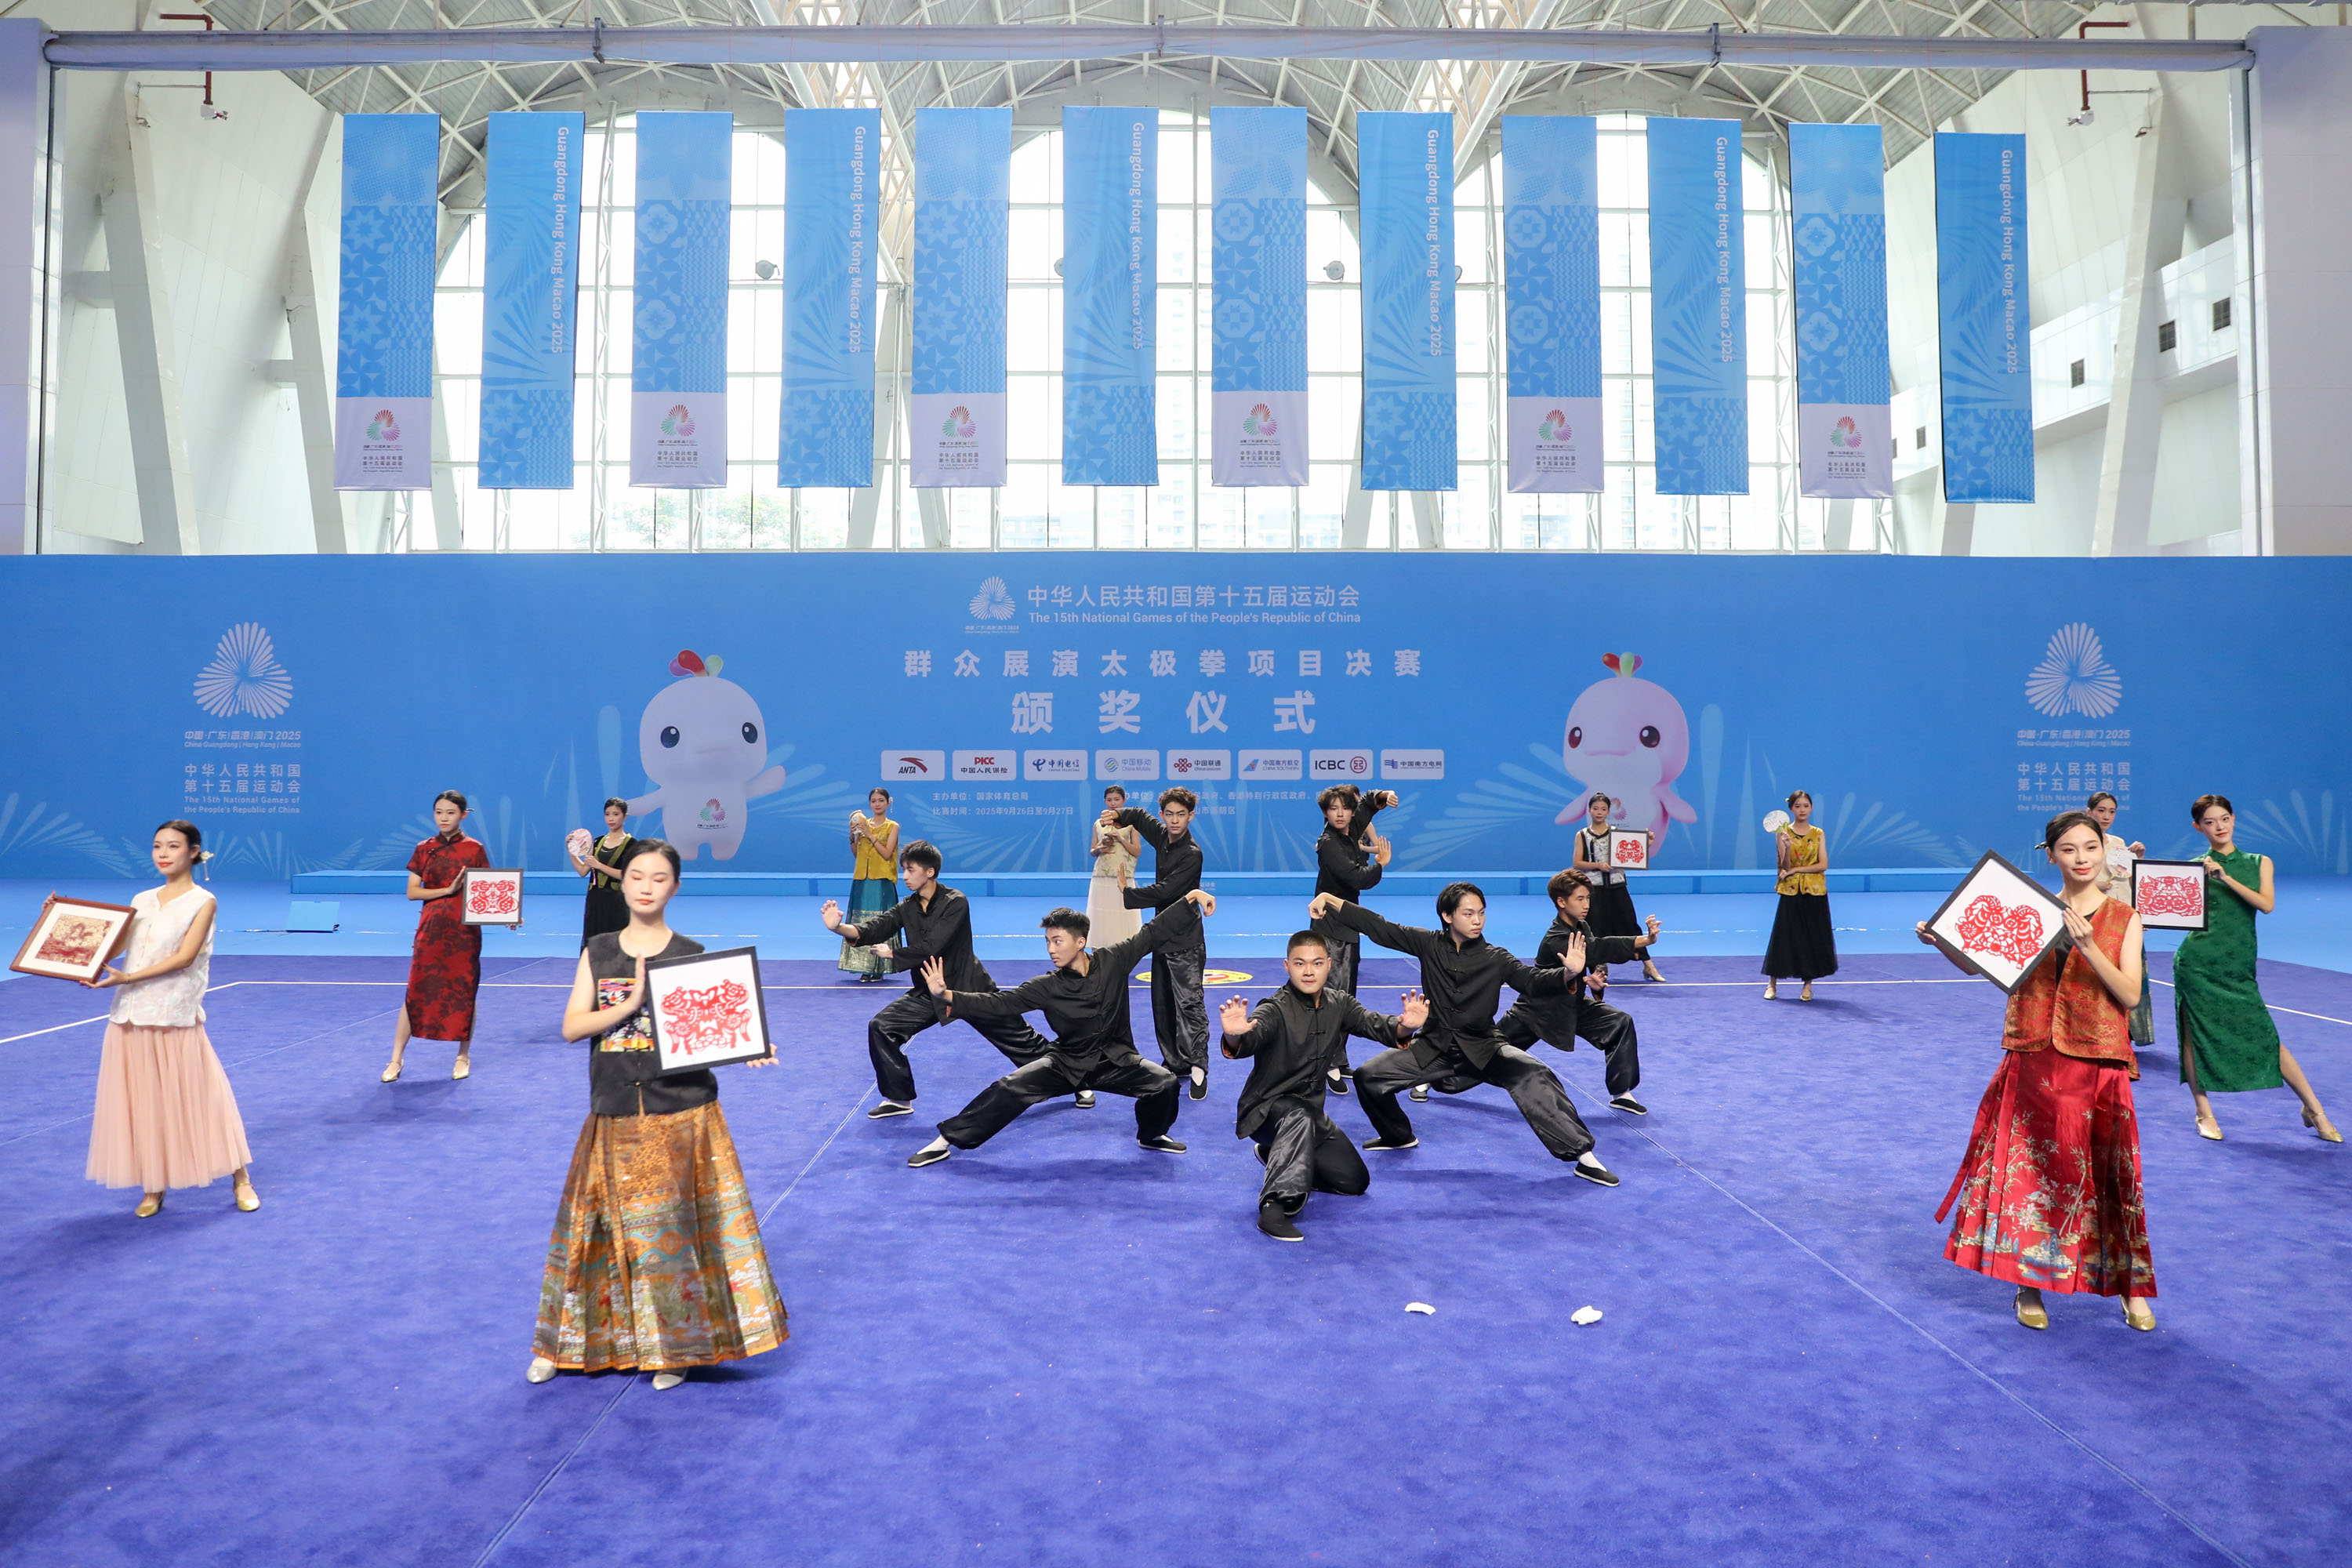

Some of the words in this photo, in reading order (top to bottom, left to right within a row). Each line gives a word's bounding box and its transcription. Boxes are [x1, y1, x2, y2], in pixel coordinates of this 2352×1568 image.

[553, 127, 570, 201] Guangdong
[851, 126, 866, 201] Guangdong
[1129, 122, 1145, 196] Guangdong
[1425, 130, 1440, 204] Guangdong
[1714, 137, 1730, 211] Guangdong
[1999, 150, 2013, 223] Guangdong
[552, 204, 568, 238] Hong
[850, 204, 865, 238] Hong
[1129, 199, 1144, 234] Hong
[1426, 207, 1440, 241] Hong
[1715, 214, 1730, 248] Hong
[551, 241, 567, 274] Kong
[848, 241, 863, 274] Kong
[1130, 237, 1143, 270] Kong
[2001, 227, 2015, 260] Hong
[1427, 245, 1441, 278] Kong
[1717, 251, 1731, 284] Kong
[1132, 273, 1143, 315] Macao
[2002, 264, 2016, 296] Kong
[553, 278, 566, 318] Macao
[851, 278, 862, 318] Macao
[1430, 281, 1441, 321] Macao
[1720, 287, 1731, 328] Macao
[1132, 318, 1143, 350] 2025
[2005, 299, 2016, 339] Macao
[551, 321, 564, 354] 2025
[849, 321, 861, 353] 2025
[1430, 325, 1442, 356] 2025
[1721, 331, 1733, 362] 2025
[2006, 343, 2017, 373] 2025
[1028, 585, 1359, 608] 中华人民共和国第十五届运动会
[1029, 612, 1050, 622] The
[1054, 612, 1079, 622] 15th
[1083, 612, 1129, 622] National
[1134, 612, 1172, 622] Games
[1176, 612, 1188, 622] of
[1190, 612, 1208, 622] the
[1212, 612, 1258, 625] People's
[1262, 612, 1311, 625] Republic
[1314, 612, 1326, 622] of
[1329, 612, 1360, 622] China
[905, 650, 1421, 677] 群众展演太极拳项目决赛
[1011, 690, 1316, 734] 颁奖仪式
[275, 731, 301, 740] 2025
[2106, 729, 2130, 739] 2025
[185, 764, 300, 777] 中华人民共和国
[975, 757, 994, 765] PICC
[1048, 759, 1080, 768] 中国电信
[1315, 760, 1345, 770] ICBC
[2018, 762, 2130, 775] 中华人民共和国
[185, 779, 300, 793] 第十五届运动会
[2018, 778, 2130, 791] 第十五届运动会
[199, 806, 230, 815] People's
[233, 806, 266, 815] Republic
